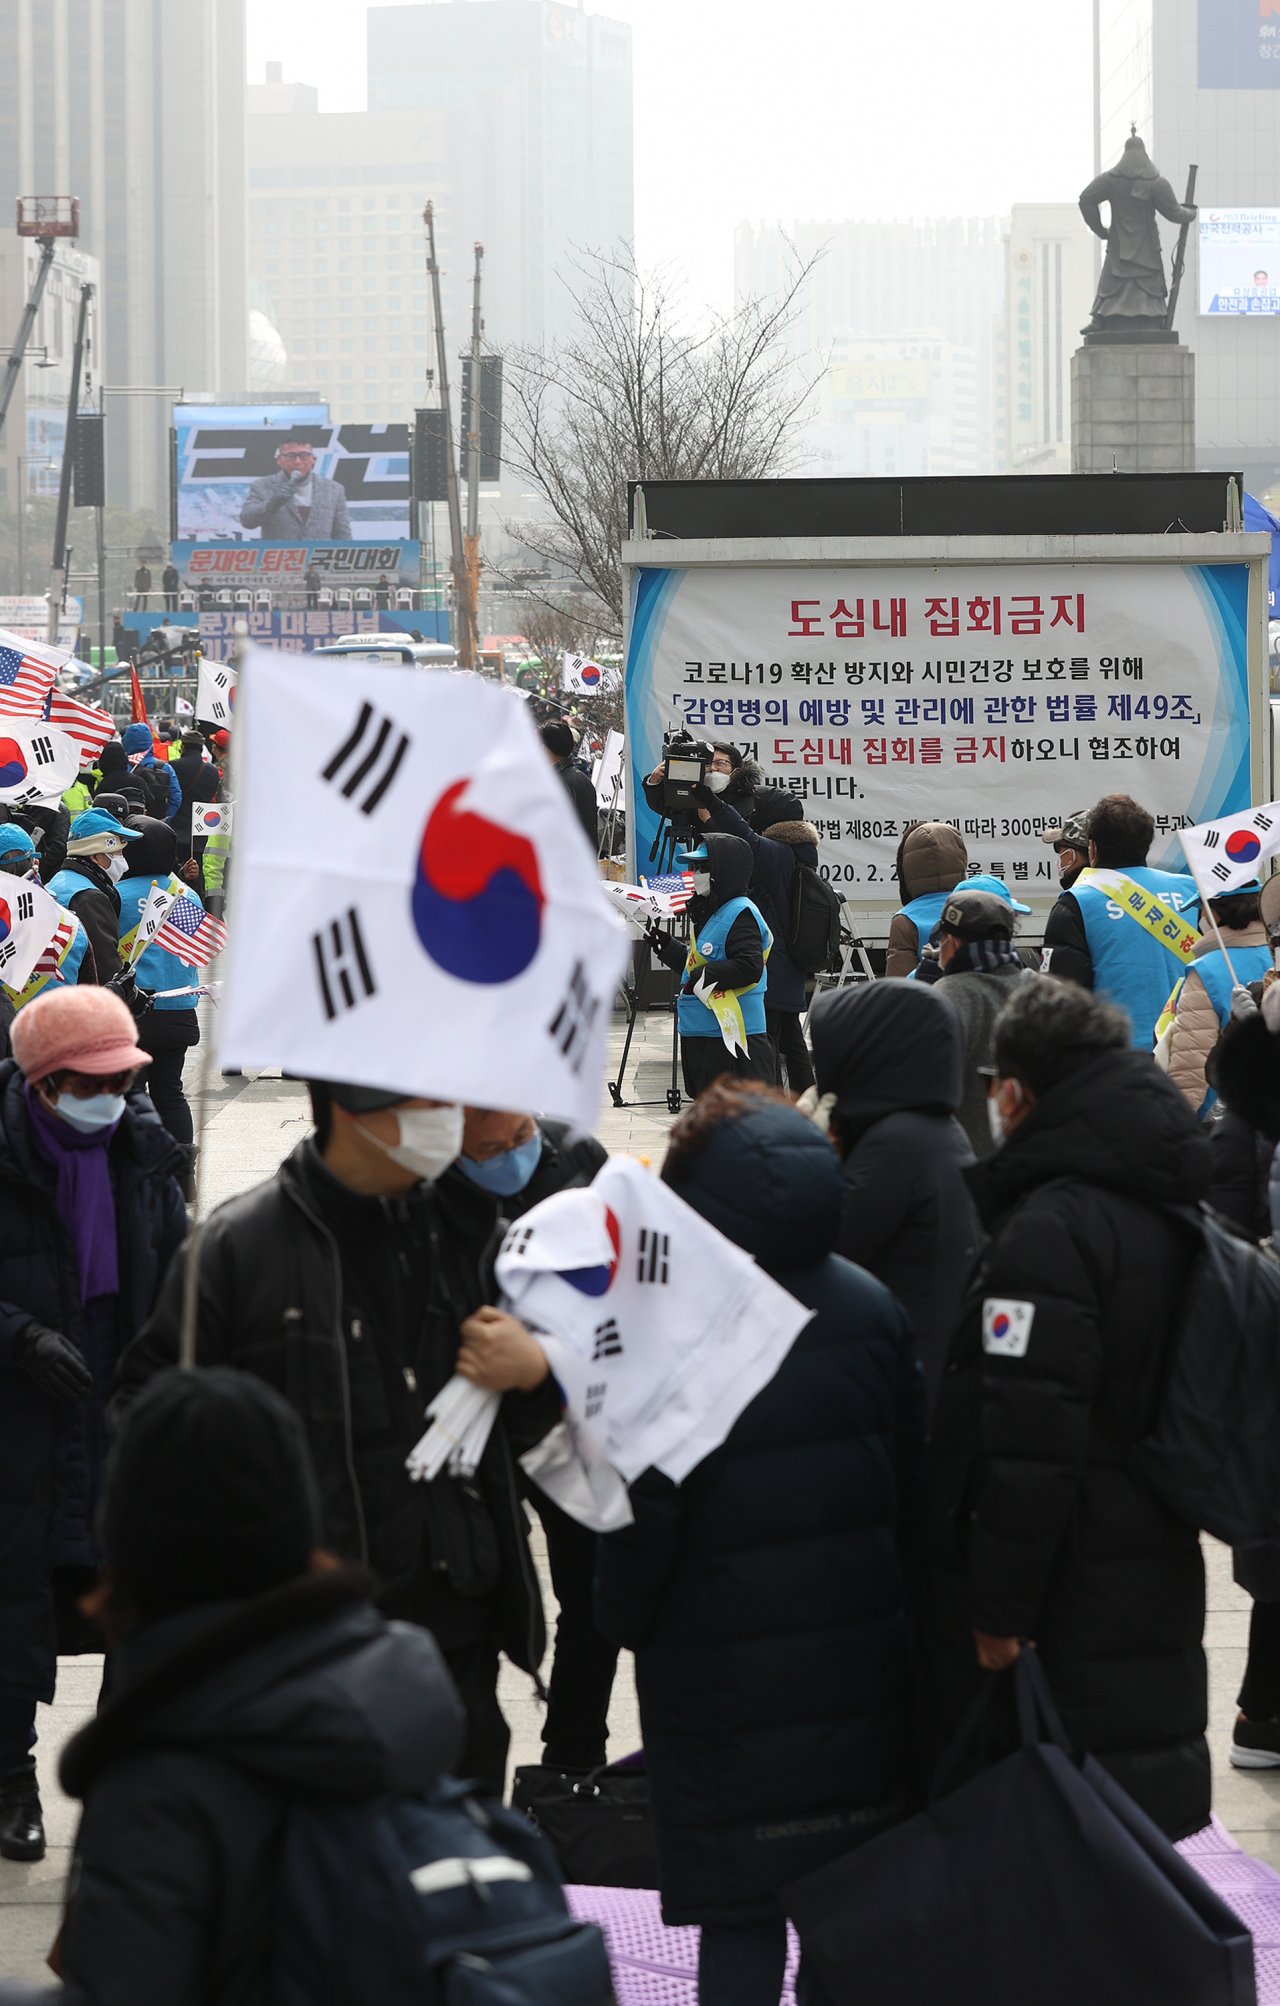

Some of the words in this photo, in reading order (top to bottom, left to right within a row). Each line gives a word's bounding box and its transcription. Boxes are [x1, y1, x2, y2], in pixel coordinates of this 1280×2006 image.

[1199, 223, 1262, 234] 한국전력공사
[1240, 213, 1277, 222] Briefing
[1217, 297, 1248, 311] 안전과
[189, 548, 259, 573] 문재인
[259, 548, 308, 572] 퇴진
[309, 547, 402, 571] 국민대회
[199, 612, 272, 636] 문재인
[281, 611, 379, 635] 대통령님
[788, 598, 906, 637] 도심내
[925, 594, 1085, 636] 집회금지
[684, 662, 782, 685] 코로나19
[791, 662, 836, 684] 확산
[845, 661, 914, 685] 방지와
[922, 660, 1014, 684] 시민건강
[1022, 658, 1090, 681] 보호를
[1099, 657, 1143, 680] 위해
[799, 699, 850, 726] 예방
[862, 699, 885, 725] 및
[895, 698, 974, 726] 관리에
[984, 696, 1037, 723] 관한
[1047, 695, 1098, 722] 법률
[772, 738, 851, 765] 도심내
[863, 738, 943, 764] 집회를
[1089, 737, 1180, 760] 협조하여
[765, 777, 864, 799] 바랍니다.
[846, 820, 898, 840] 제80조
[965, 818, 996, 838] 따라
[818, 865, 860, 882] 020.
[867, 864, 884, 882] 2.
[1105, 892, 1185, 920] SFF
[1128, 891, 1181, 940] 문재인
